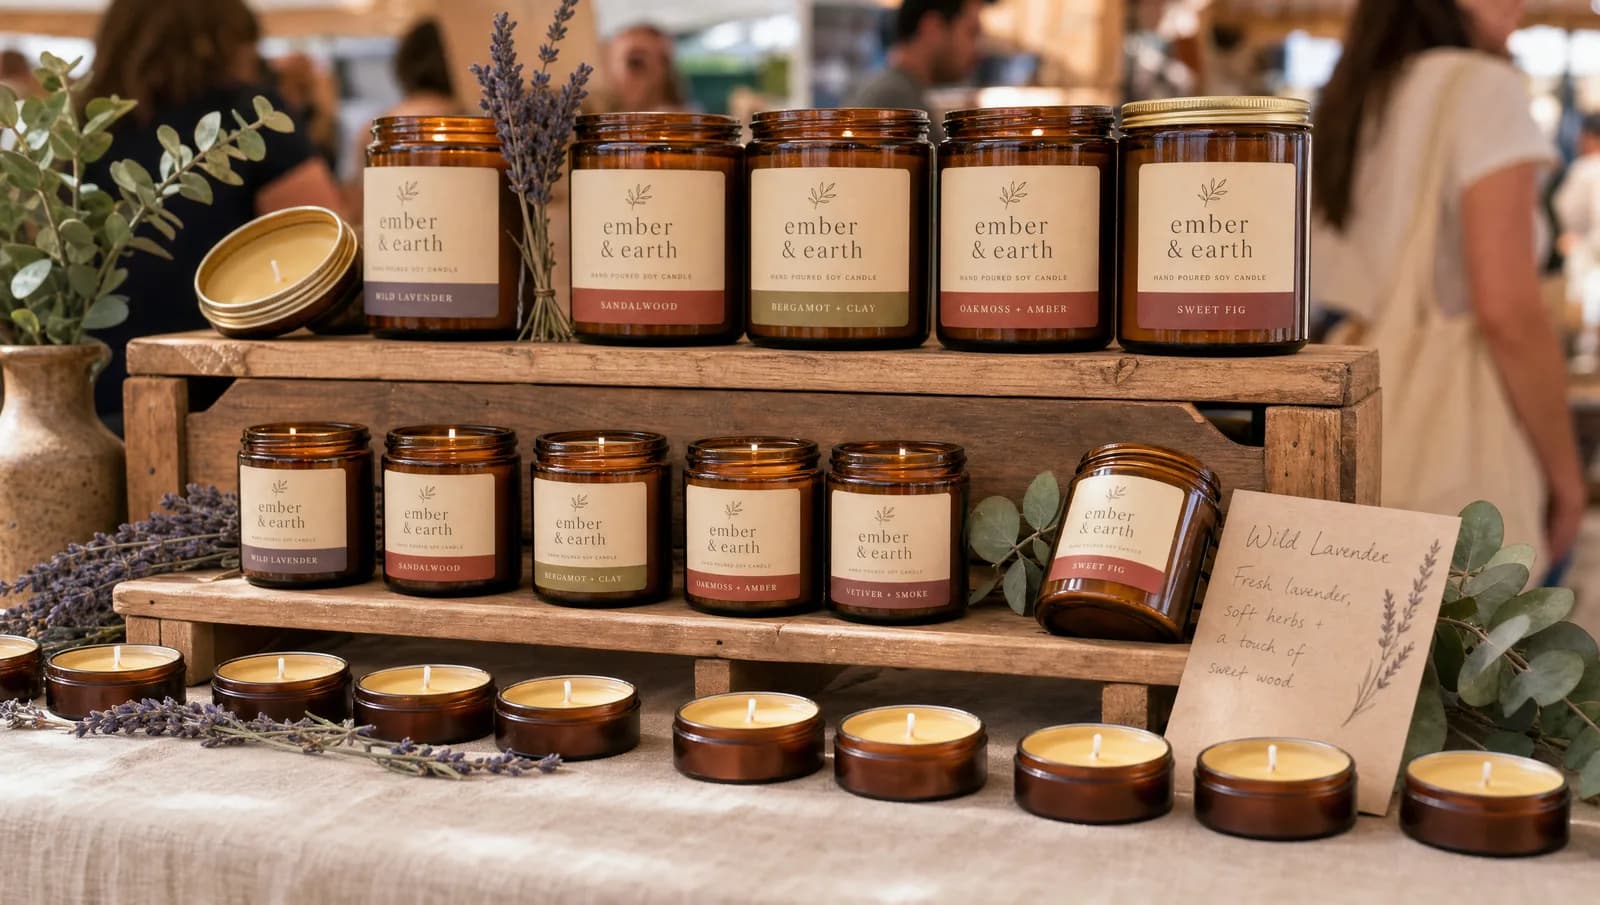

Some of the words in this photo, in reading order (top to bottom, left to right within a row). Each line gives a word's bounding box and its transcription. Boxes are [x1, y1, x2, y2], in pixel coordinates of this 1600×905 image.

[380, 212, 438, 230] ember
[604, 217, 672, 235] ember
[785, 216, 858, 235] ember
[975, 216, 1048, 234] ember
[1171, 214, 1248, 234] ember
[378, 234, 388, 251] &
[393, 234, 442, 252] earth
[601, 240, 614, 258] &
[622, 240, 677, 258] earth
[782, 240, 796, 258] &
[804, 240, 862, 258] earth
[972, 240, 986, 258] &
[994, 240, 1052, 258] earth
[1168, 240, 1182, 258] &
[1192, 240, 1252, 258] earth
[376, 292, 395, 300] WILD
[398, 293, 453, 302] LAVENDER
[600, 301, 678, 310] SANDALWOOD
[772, 302, 830, 312] BERGAMOT
[846, 304, 876, 312] CLAY
[960, 304, 1010, 314] OAKMOSS
[1027, 305, 1068, 313] AMBER
[1178, 306, 1220, 314] SWEET
[1225, 306, 1246, 314] FIG
[258, 500, 302, 514] ember
[404, 508, 448, 520] ember
[258, 514, 266, 528] &
[269, 516, 304, 528] earth
[1085, 507, 1134, 522] ember
[404, 522, 411, 534] &
[416, 523, 452, 536] earth
[556, 516, 602, 530] ember
[1080, 522, 1088, 534] &
[1094, 524, 1134, 538] earth
[710, 524, 756, 538] ember
[858, 530, 908, 543] ember
[554, 532, 563, 544] &
[567, 533, 606, 545] earth
[1246, 525, 1301, 550] Wild
[1310, 531, 1391, 563] Lavender
[708, 539, 716, 552] &
[721, 541, 760, 553] earth
[857, 545, 866, 558] &
[872, 546, 912, 560] earth
[398, 562, 460, 572] SANDALWOOD
[1072, 562, 1104, 570] SWEET
[1107, 565, 1125, 574] FIG
[544, 572, 586, 582] BERGAMOT
[696, 580, 733, 591] OAKMOSS
[846, 587, 883, 598] VETIVER
[896, 590, 928, 598] SMOKE
[1232, 566, 1272, 591] Fresh
[1285, 576, 1350, 606] lavender,
[1224, 604, 1256, 626] soft
[1266, 608, 1304, 628] herbs
[1217, 633, 1227, 643] a
[1240, 634, 1276, 653] touch
[1288, 643, 1306, 667] of
[1208, 663, 1248, 680] sweet
[1256, 673, 1295, 688] wood
